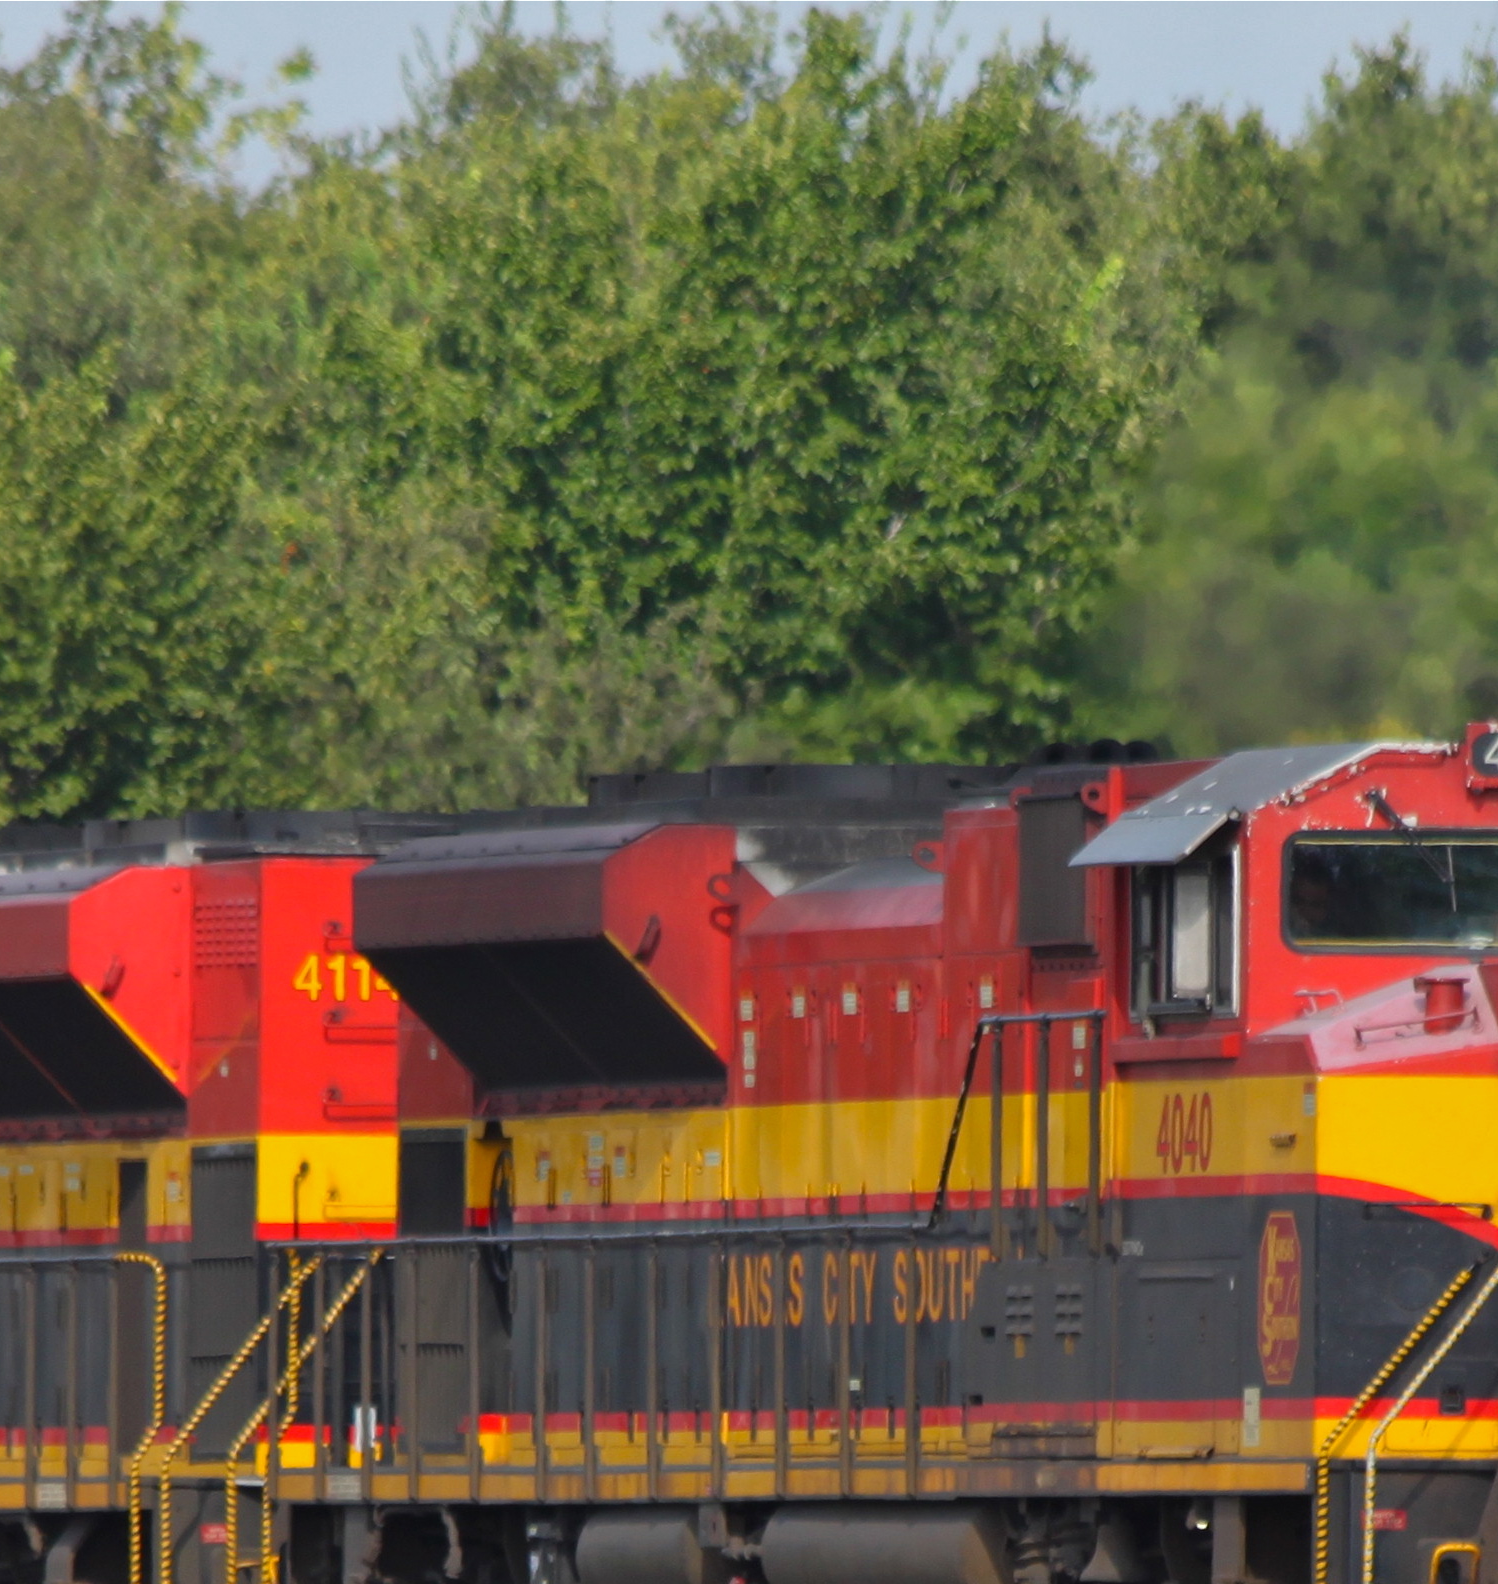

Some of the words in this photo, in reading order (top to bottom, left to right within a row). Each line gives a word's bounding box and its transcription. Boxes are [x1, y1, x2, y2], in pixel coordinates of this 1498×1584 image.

[1156, 1091, 1213, 1175] 4040
[711, 1251, 804, 1327] ANSS
[822, 1250, 877, 1326] CTY
